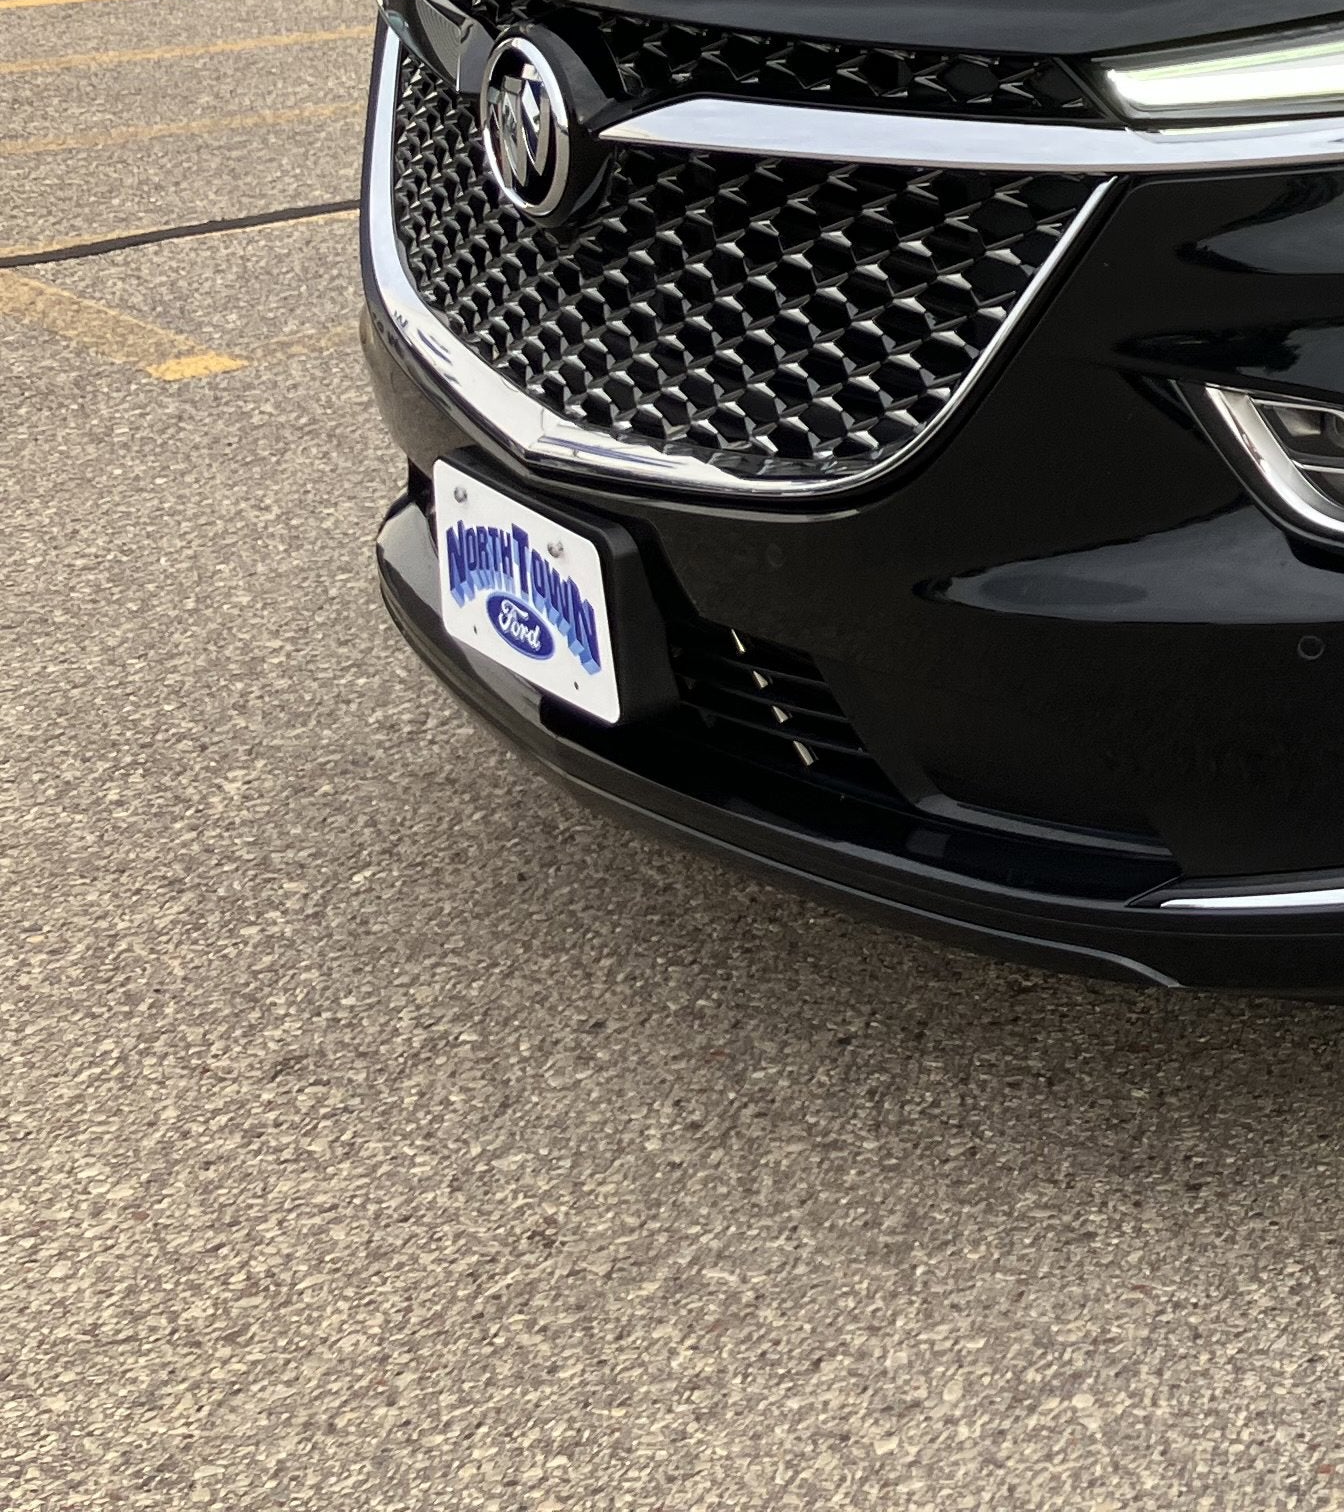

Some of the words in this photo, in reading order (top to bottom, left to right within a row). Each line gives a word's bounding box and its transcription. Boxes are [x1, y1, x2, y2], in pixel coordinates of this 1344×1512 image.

[446, 519, 514, 608] NORTH
[511, 523, 602, 676] TOWN
[498, 598, 544, 652] Ford
